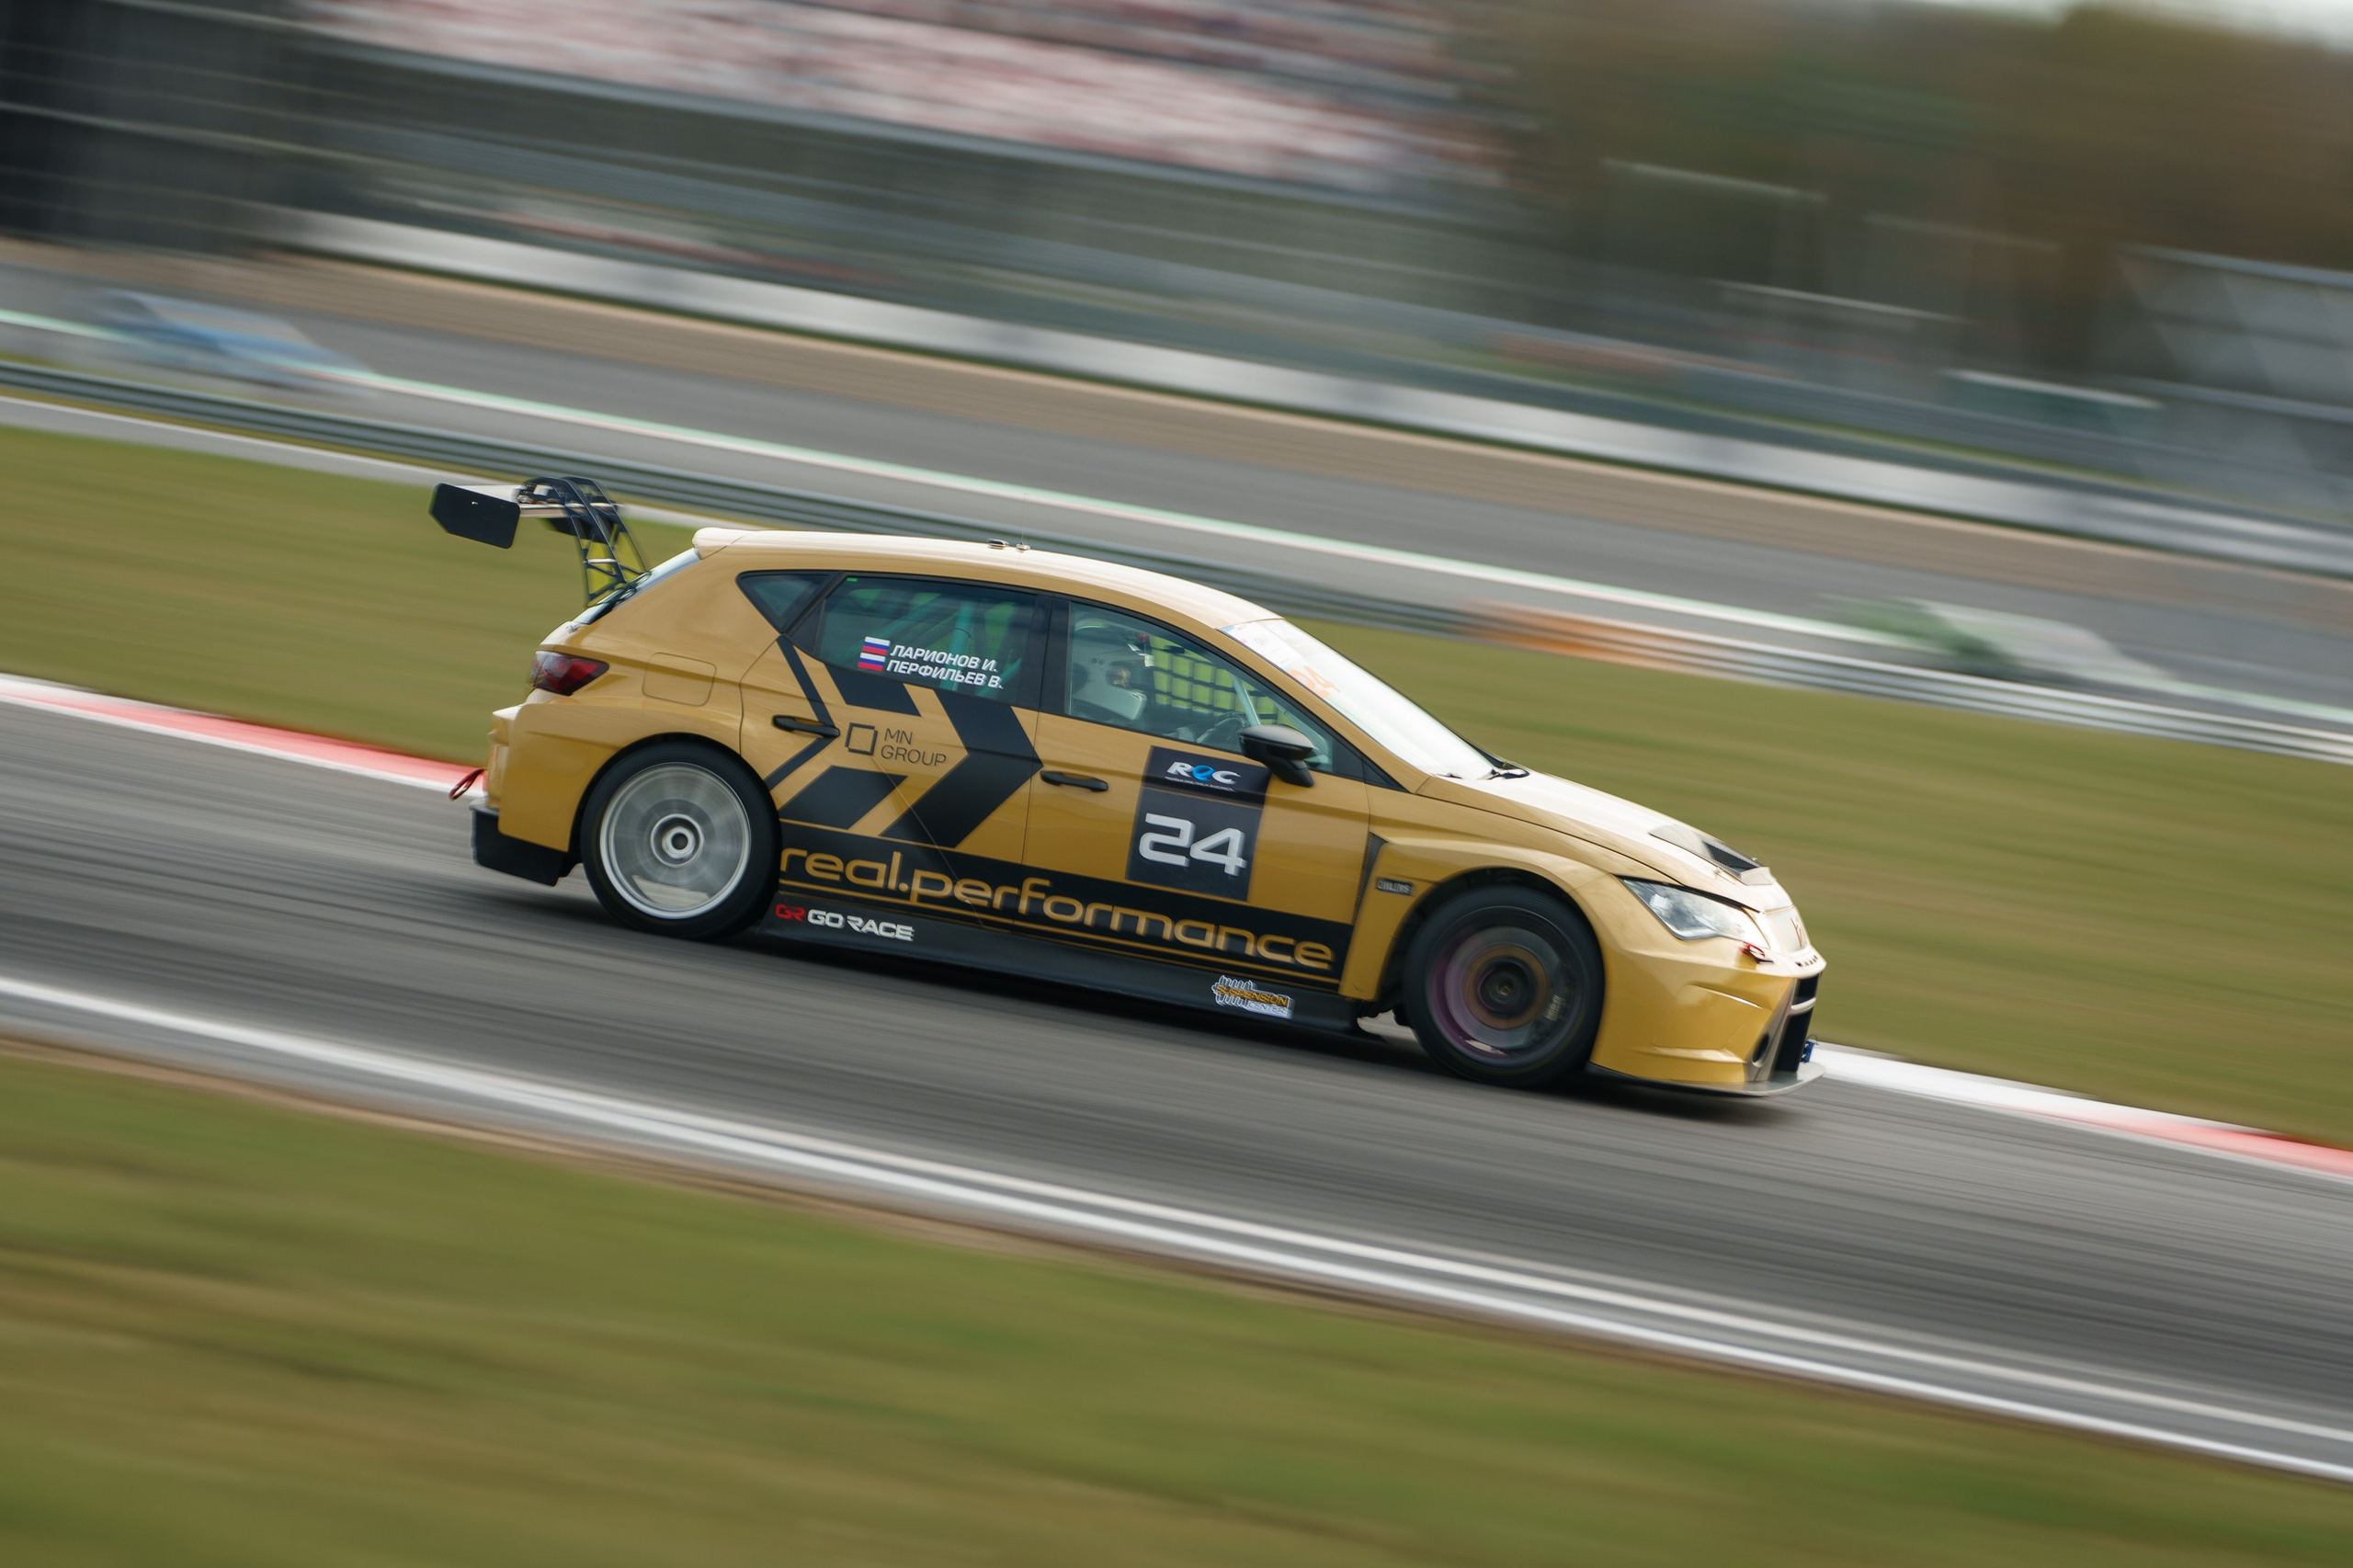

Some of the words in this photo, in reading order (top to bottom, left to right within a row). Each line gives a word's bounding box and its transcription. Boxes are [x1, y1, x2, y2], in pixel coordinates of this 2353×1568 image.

[890, 644, 981, 670] ЛАРИОНОВ
[981, 658, 999, 673] И.
[886, 660, 987, 687] ПЕРФИЛЬЕВ
[987, 676, 1005, 689] В.
[884, 728, 913, 744] MN
[881, 744, 947, 767] GROUP
[1139, 813, 1247, 876] 24
[775, 903, 806, 923] GR
[807, 909, 845, 929] GO
[847, 915, 915, 943] RACE
[779, 847, 1335, 971] real.performance
[1215, 984, 1288, 1006] SUSPENSION
